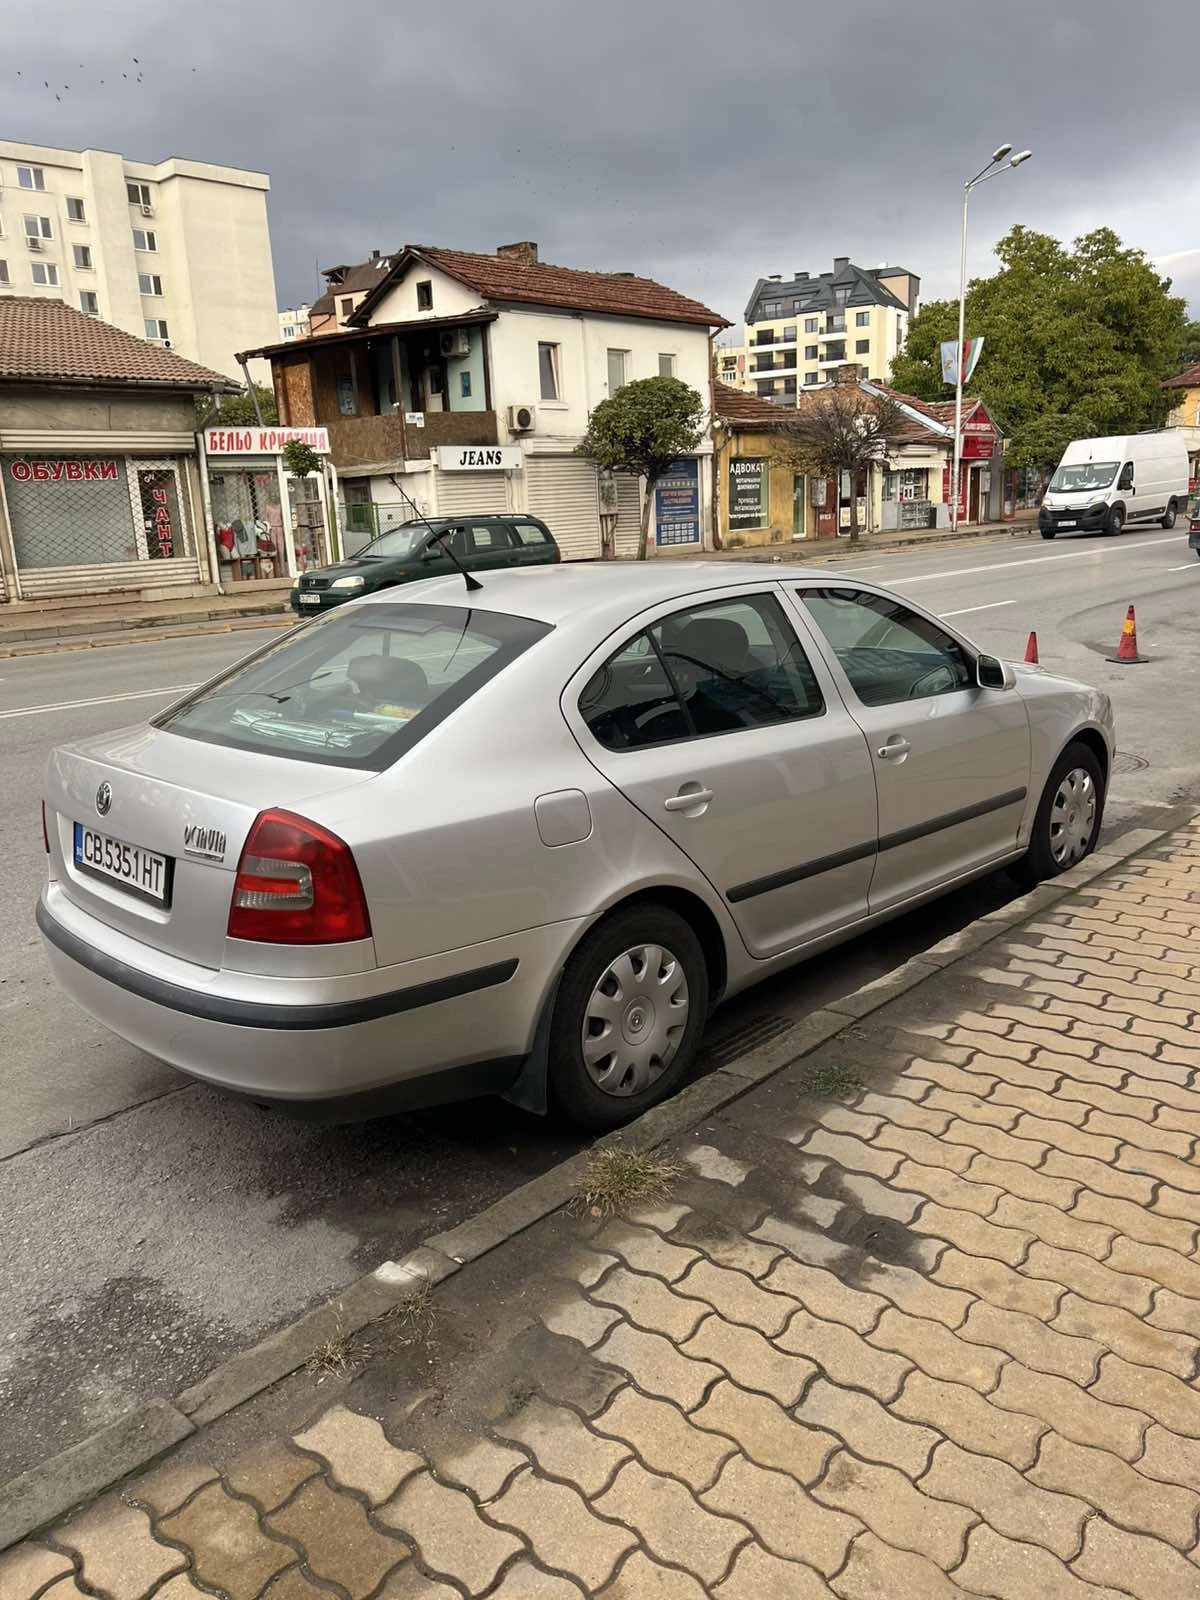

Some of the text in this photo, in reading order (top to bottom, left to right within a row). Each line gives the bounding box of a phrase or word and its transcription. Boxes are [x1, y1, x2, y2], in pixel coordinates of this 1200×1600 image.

[209, 431, 252, 452] БЕЛЬО
[459, 450, 502, 466] JEANS
[10, 460, 119, 482] ОБУВКИ
[730, 463, 764, 475] АДВОКАТ
[182, 824, 226, 854] OCTAVIA
